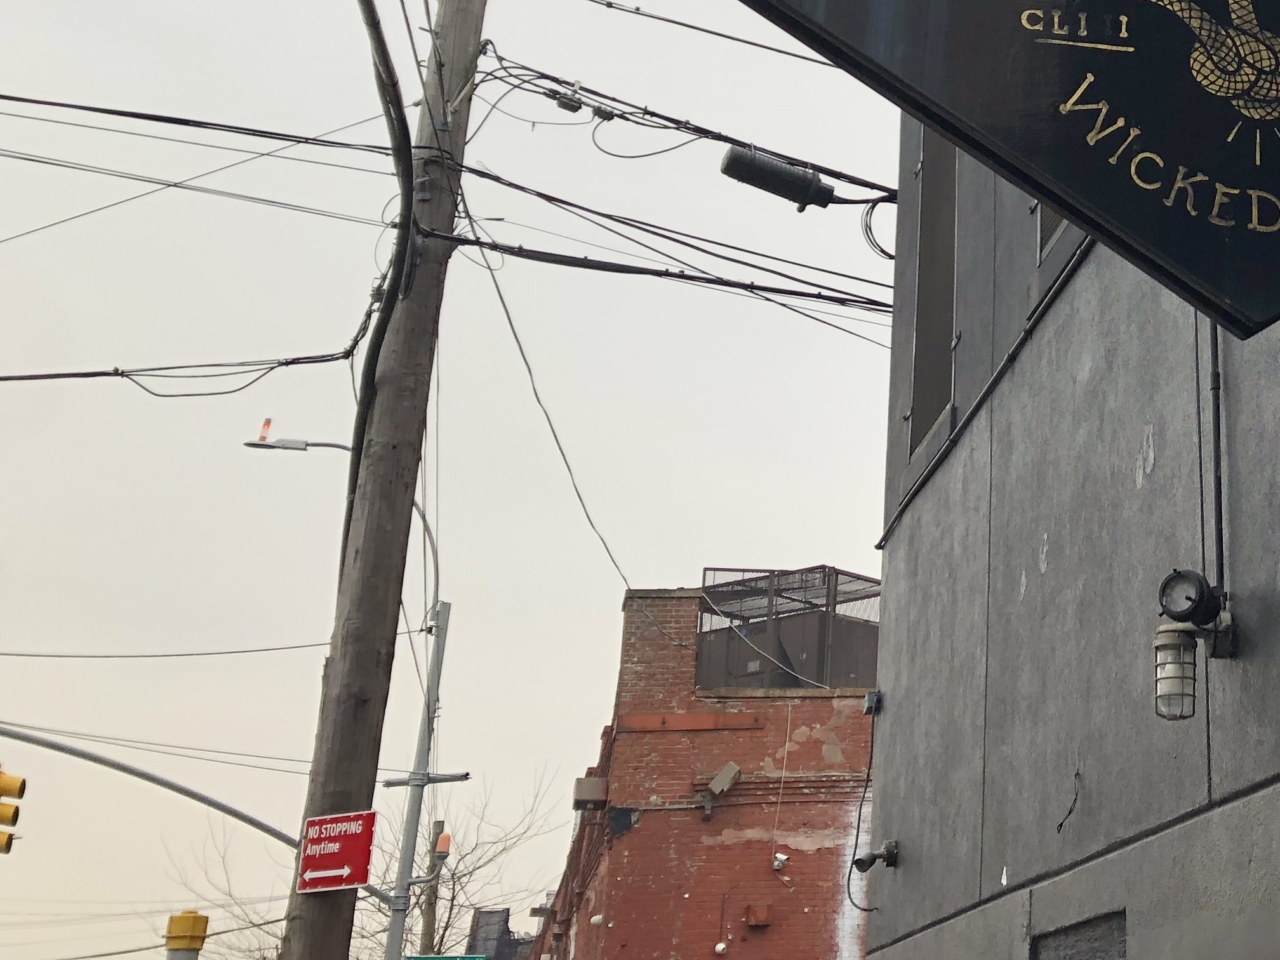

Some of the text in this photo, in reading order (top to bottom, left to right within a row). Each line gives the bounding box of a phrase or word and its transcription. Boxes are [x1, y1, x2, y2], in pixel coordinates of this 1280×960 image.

[307, 821, 362, 839] NO STOPPING
[305, 841, 340, 857] Anytime
